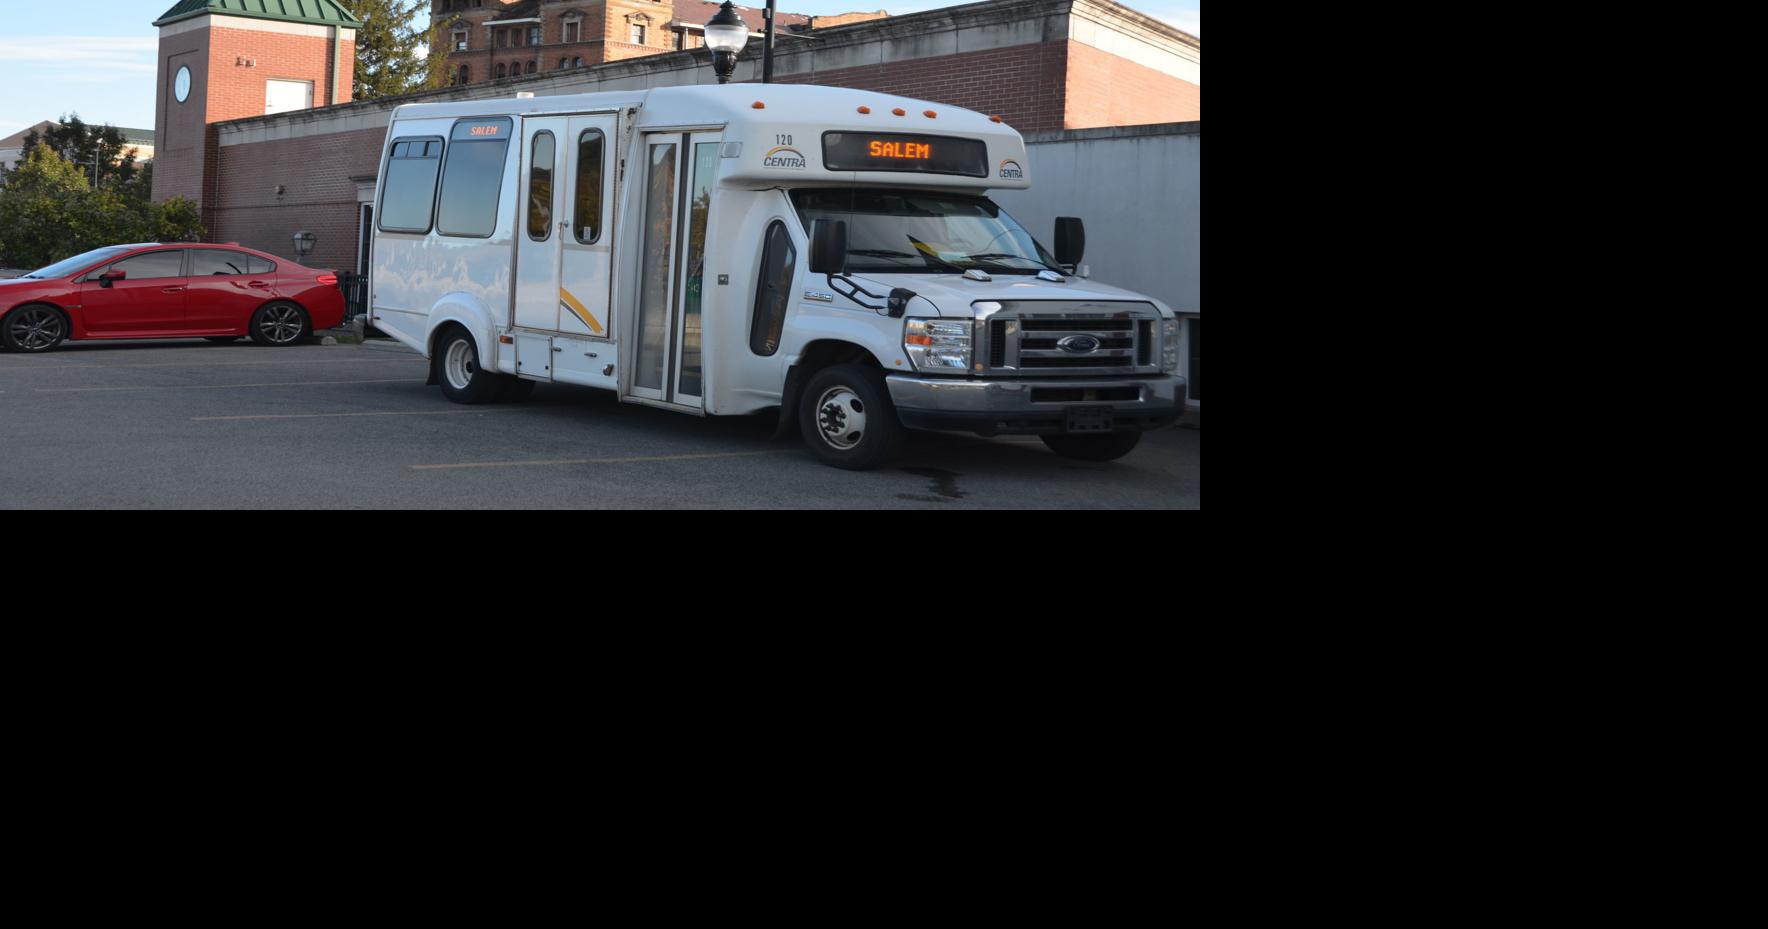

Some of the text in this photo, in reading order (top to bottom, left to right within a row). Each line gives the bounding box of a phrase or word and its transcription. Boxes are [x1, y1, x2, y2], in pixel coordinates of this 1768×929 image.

[471, 125, 498, 136] SALEM
[776, 134, 793, 145] 120
[870, 141, 929, 159] SALEM
[763, 156, 806, 168] CENTRA
[1000, 169, 1023, 178] CENTRA
